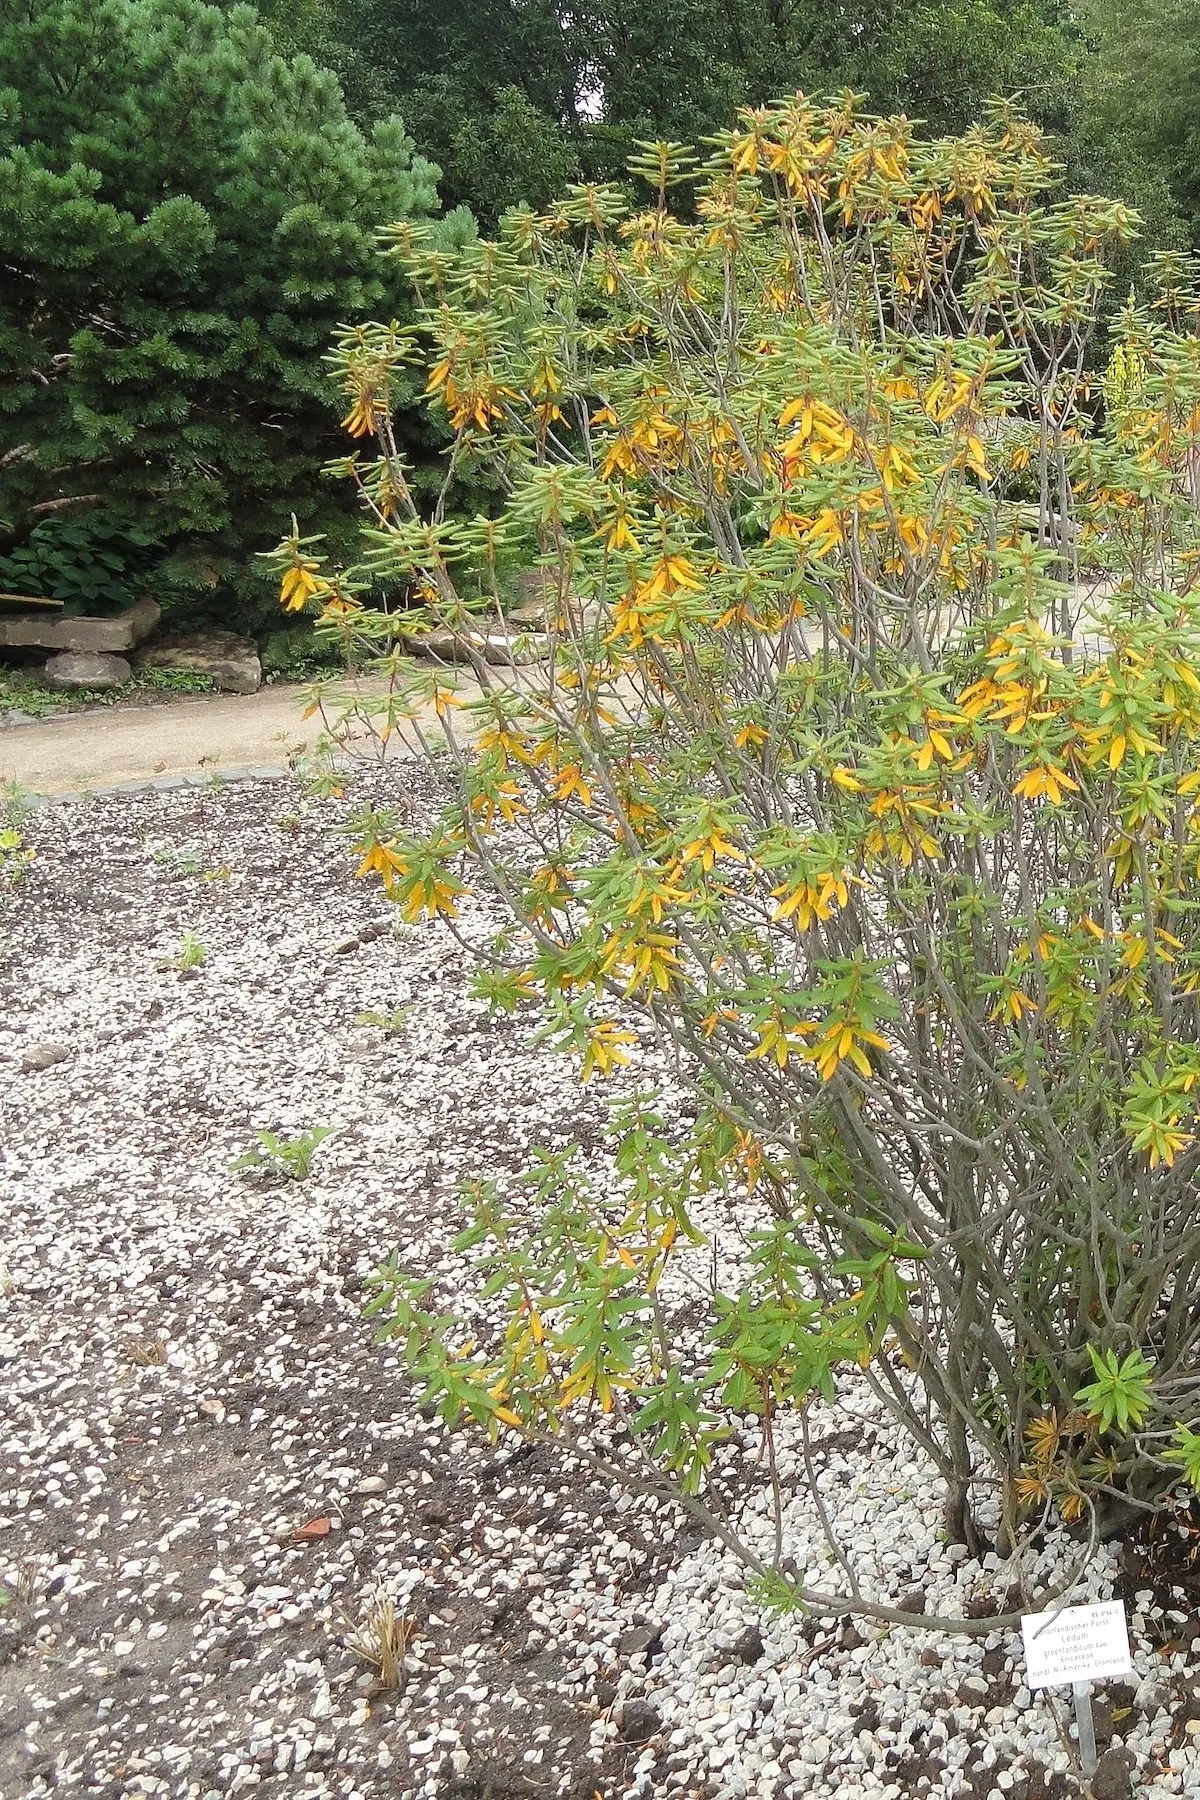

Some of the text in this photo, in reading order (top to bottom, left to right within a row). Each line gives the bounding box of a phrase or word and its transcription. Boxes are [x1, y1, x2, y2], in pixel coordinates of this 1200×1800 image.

[1090, 1619, 1109, 1628] Porst
[1061, 1632, 1088, 1643] Ledum
[1043, 1643, 1094, 1659] groenlandicum
[1060, 1652, 1094, 1663] Ericaceae
